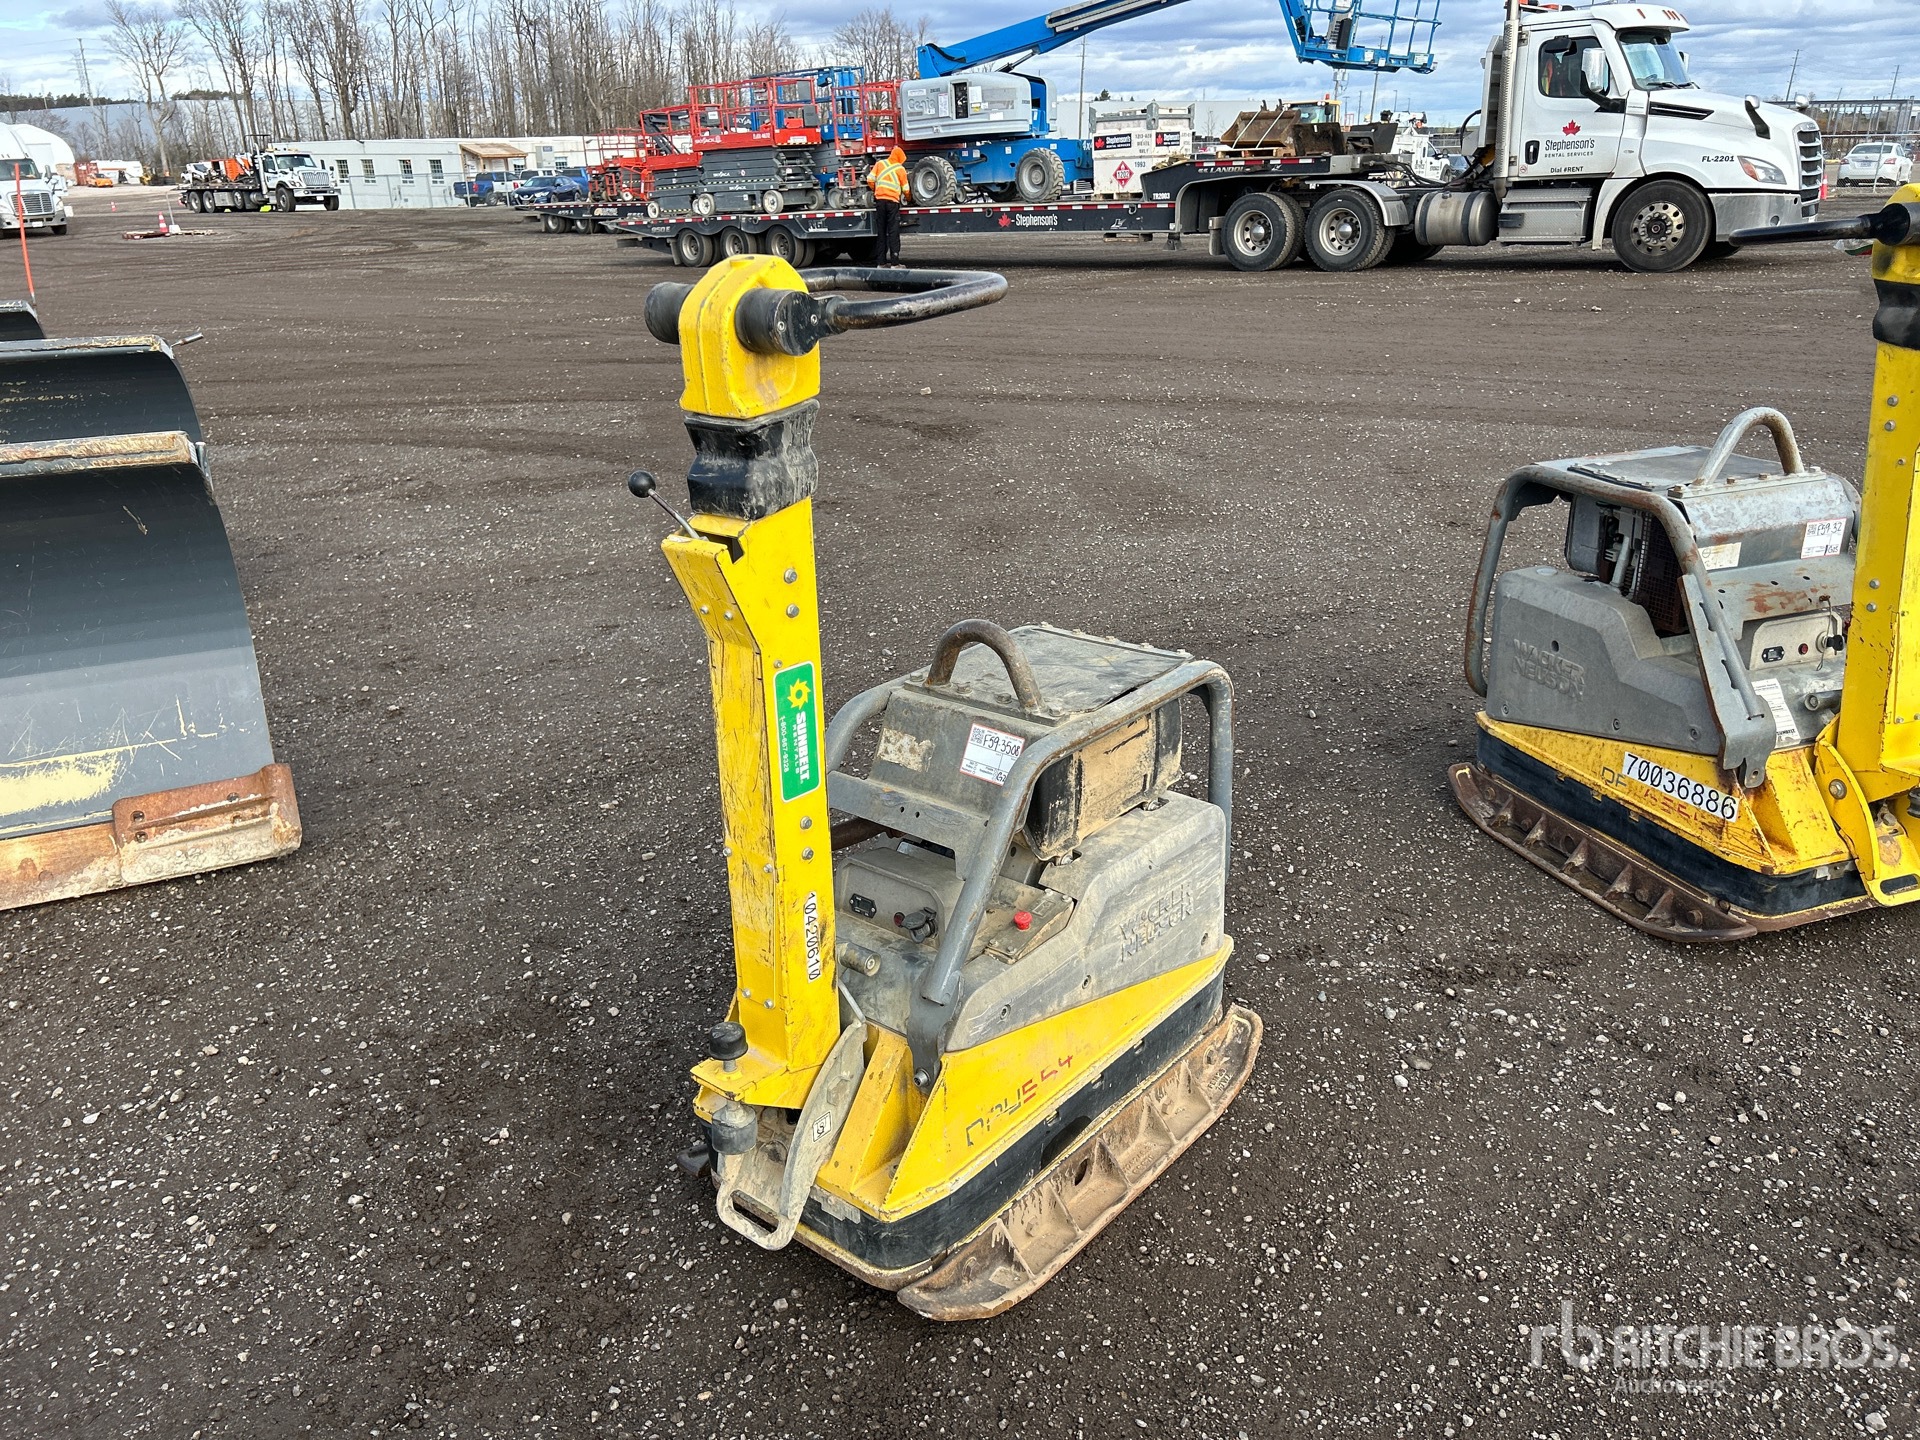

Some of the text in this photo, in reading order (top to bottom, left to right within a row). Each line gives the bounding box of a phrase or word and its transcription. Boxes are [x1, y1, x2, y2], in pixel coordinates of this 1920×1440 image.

[1544, 138, 1595, 152] Stephenson's
[1701, 155, 1735, 163] FL-2201
[1015, 213, 1058, 227] Stephenson's
[1511, 655, 1584, 702] NEUSON
[1513, 638, 1585, 685] WACKER
[792, 724, 800, 775] RENTALS
[795, 711, 811, 783] SUNBELT
[1625, 752, 1738, 821] 70036886
[804, 892, 821, 981] 10420610
